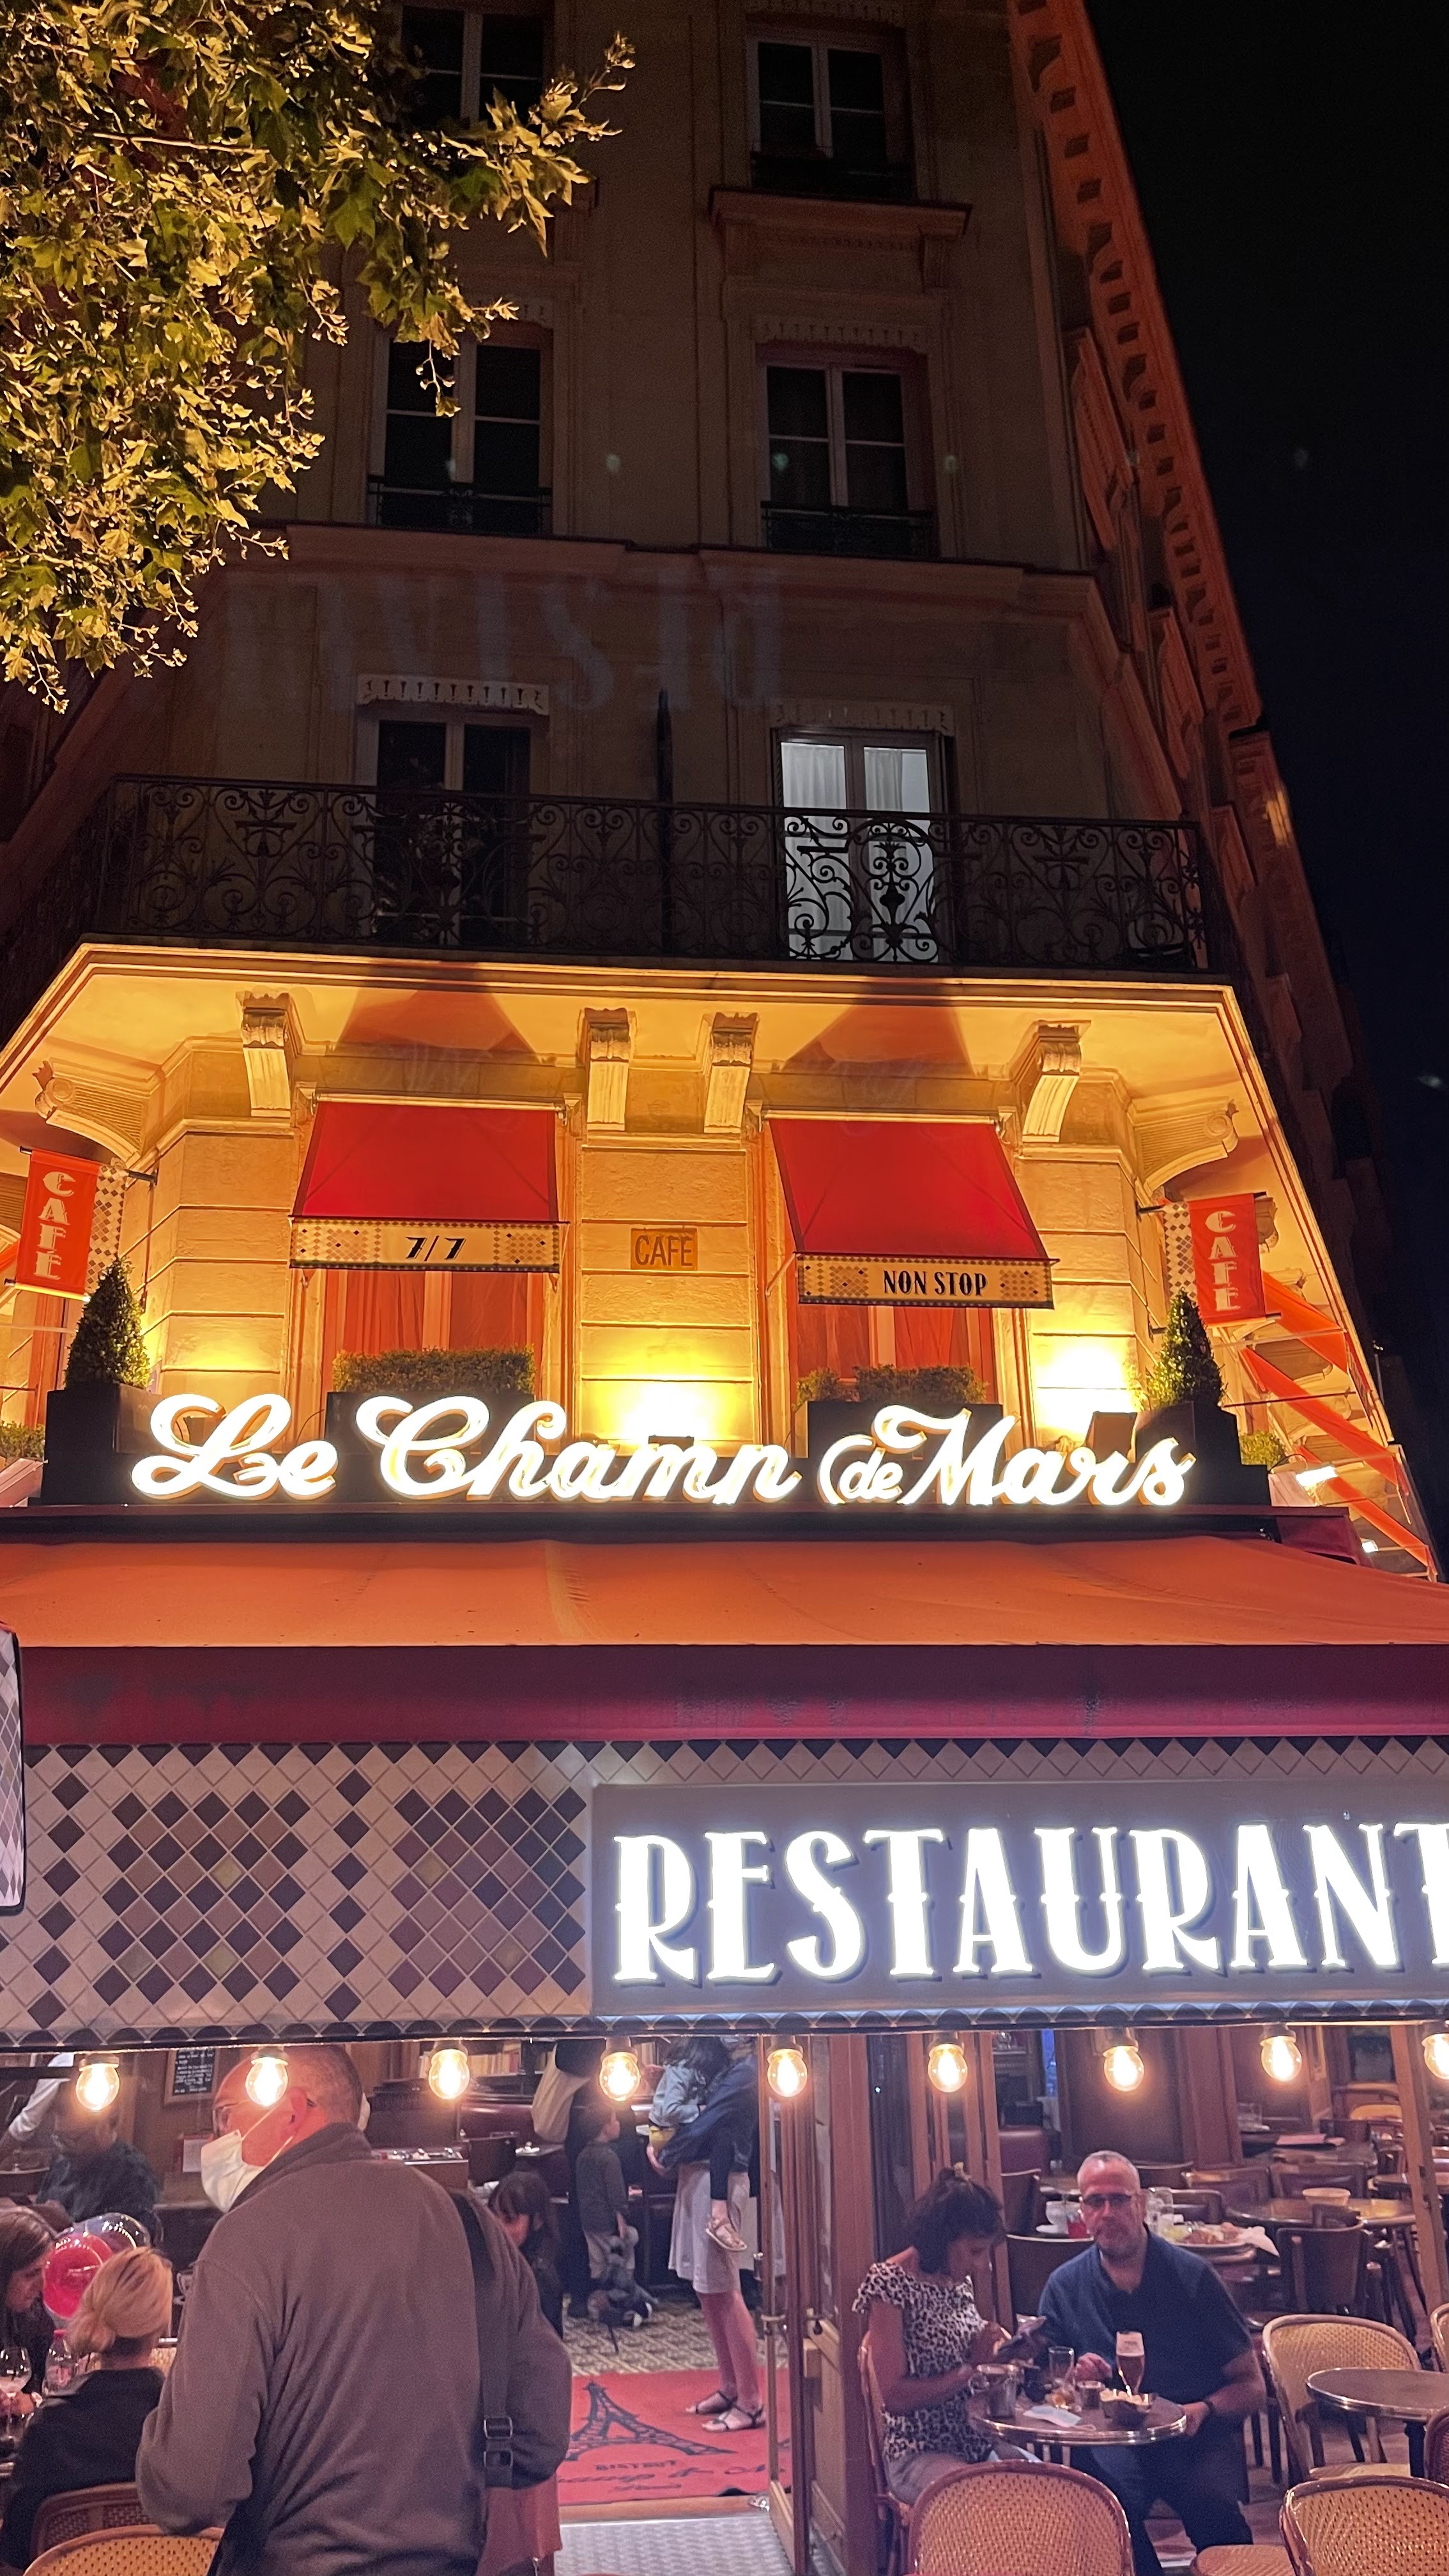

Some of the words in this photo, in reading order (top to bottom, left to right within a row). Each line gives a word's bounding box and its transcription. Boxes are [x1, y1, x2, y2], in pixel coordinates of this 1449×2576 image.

[405, 1235, 466, 1262] 7/7
[884, 1270, 928, 1294] NON
[934, 1271, 988, 1297] STOP
[131, 1393, 339, 1501] Le
[834, 1445, 904, 1503] de
[870, 1404, 1195, 1506] Mars
[613, 1822, 1449, 1983] RESTAURANT
